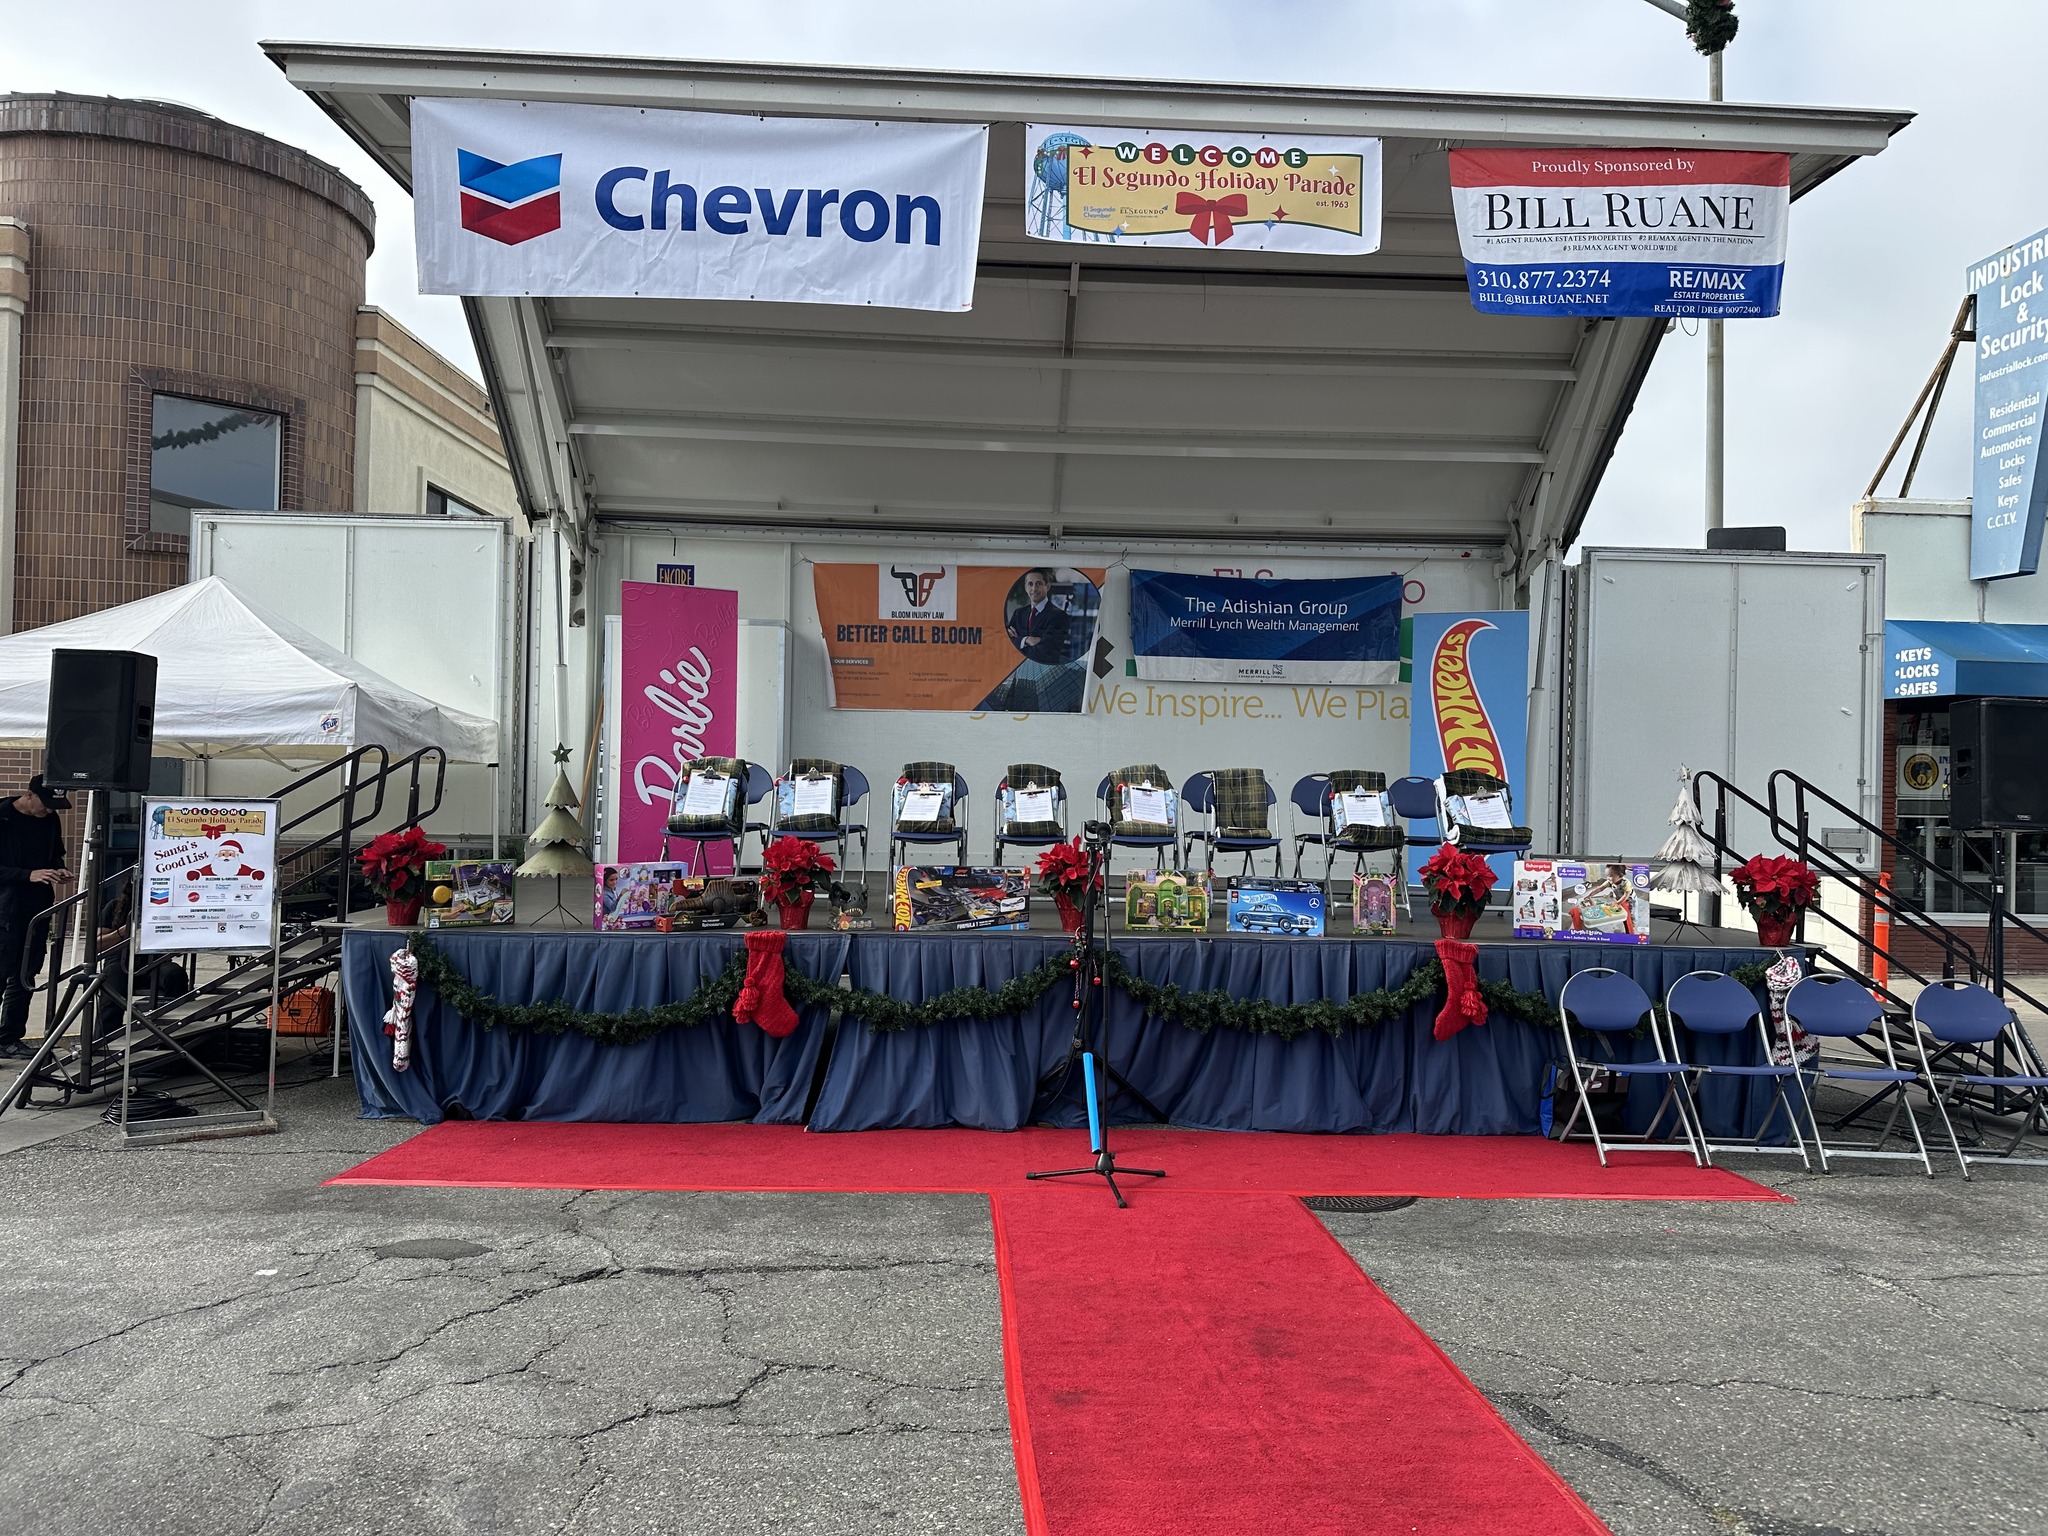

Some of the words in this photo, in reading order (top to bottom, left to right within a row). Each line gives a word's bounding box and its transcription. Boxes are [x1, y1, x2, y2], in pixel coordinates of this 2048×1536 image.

[1117, 146, 1301, 166] WELCOME
[1531, 160, 1591, 174] Proudly
[1594, 159, 1674, 175] Sponsored
[1677, 158, 1695, 173] by
[1073, 166, 1096, 187] El
[1102, 167, 1190, 191] Segundo
[1195, 168, 1279, 196] Holiday
[1283, 173, 1357, 197] Parade
[594, 166, 942, 246] Chevron
[1330, 201, 1350, 209] 1963
[1485, 193, 1590, 231] BILL
[1602, 192, 1754, 231] RUANE
[1588, 234, 1632, 242] PROPERTIES
[1727, 237, 1754, 245] NATION
[1477, 269, 1611, 290] 310.877.2374
[1669, 270, 1746, 290] RE/MAX
[1479, 292, 1610, 305] BILL@BILLRUANE.NET
[1673, 291, 1700, 299] ESTATE
[1701, 292, 1745, 300] PROPERTIES
[2000, 274, 2043, 309] Lock
[1654, 305, 1695, 314] REALTOR
[1725, 305, 1761, 314] 00972400
[2016, 302, 2029, 324] &
[1989, 392, 2040, 420] Residential
[1982, 413, 2036, 440] Commercial
[1980, 434, 2032, 459] Automotive
[1999, 454, 2026, 471] Locks
[1998, 475, 2022, 490] Safes
[1998, 494, 2019, 508] Keys
[1987, 511, 2017, 530] C.C.T.V.
[891, 610, 910, 619] BLOOM
[911, 610, 931, 619] INJURY
[932, 611, 945, 620] LAW
[1185, 596, 1216, 613] The
[1221, 598, 1293, 615] Adishian
[1299, 600, 1348, 619] Group
[1170, 616, 1206, 629] Merrill
[1210, 618, 1243, 633] Lynch
[1246, 618, 1285, 631] Wealth
[1288, 619, 1359, 634] Management
[837, 624, 888, 643] BETTER
[892, 625, 926, 645] CALL
[931, 626, 982, 645] BLOOM
[1900, 647, 1932, 663] KEYS
[1900, 663, 1940, 680] LOCKS
[1900, 681, 1938, 696] SAFES
[1087, 684, 1138, 715] We
[1145, 686, 1283, 725] Inspire...
[1292, 687, 1347, 719] We
[1356, 690, 1411, 721] Pla
[176, 816, 207, 824] Segundo
[208, 816, 236, 824] Holiday
[181, 808, 246, 816] WELCOME
[153, 841, 198, 861] Santa's
[155, 855, 186, 873] Good
[187, 850, 210, 864] List
